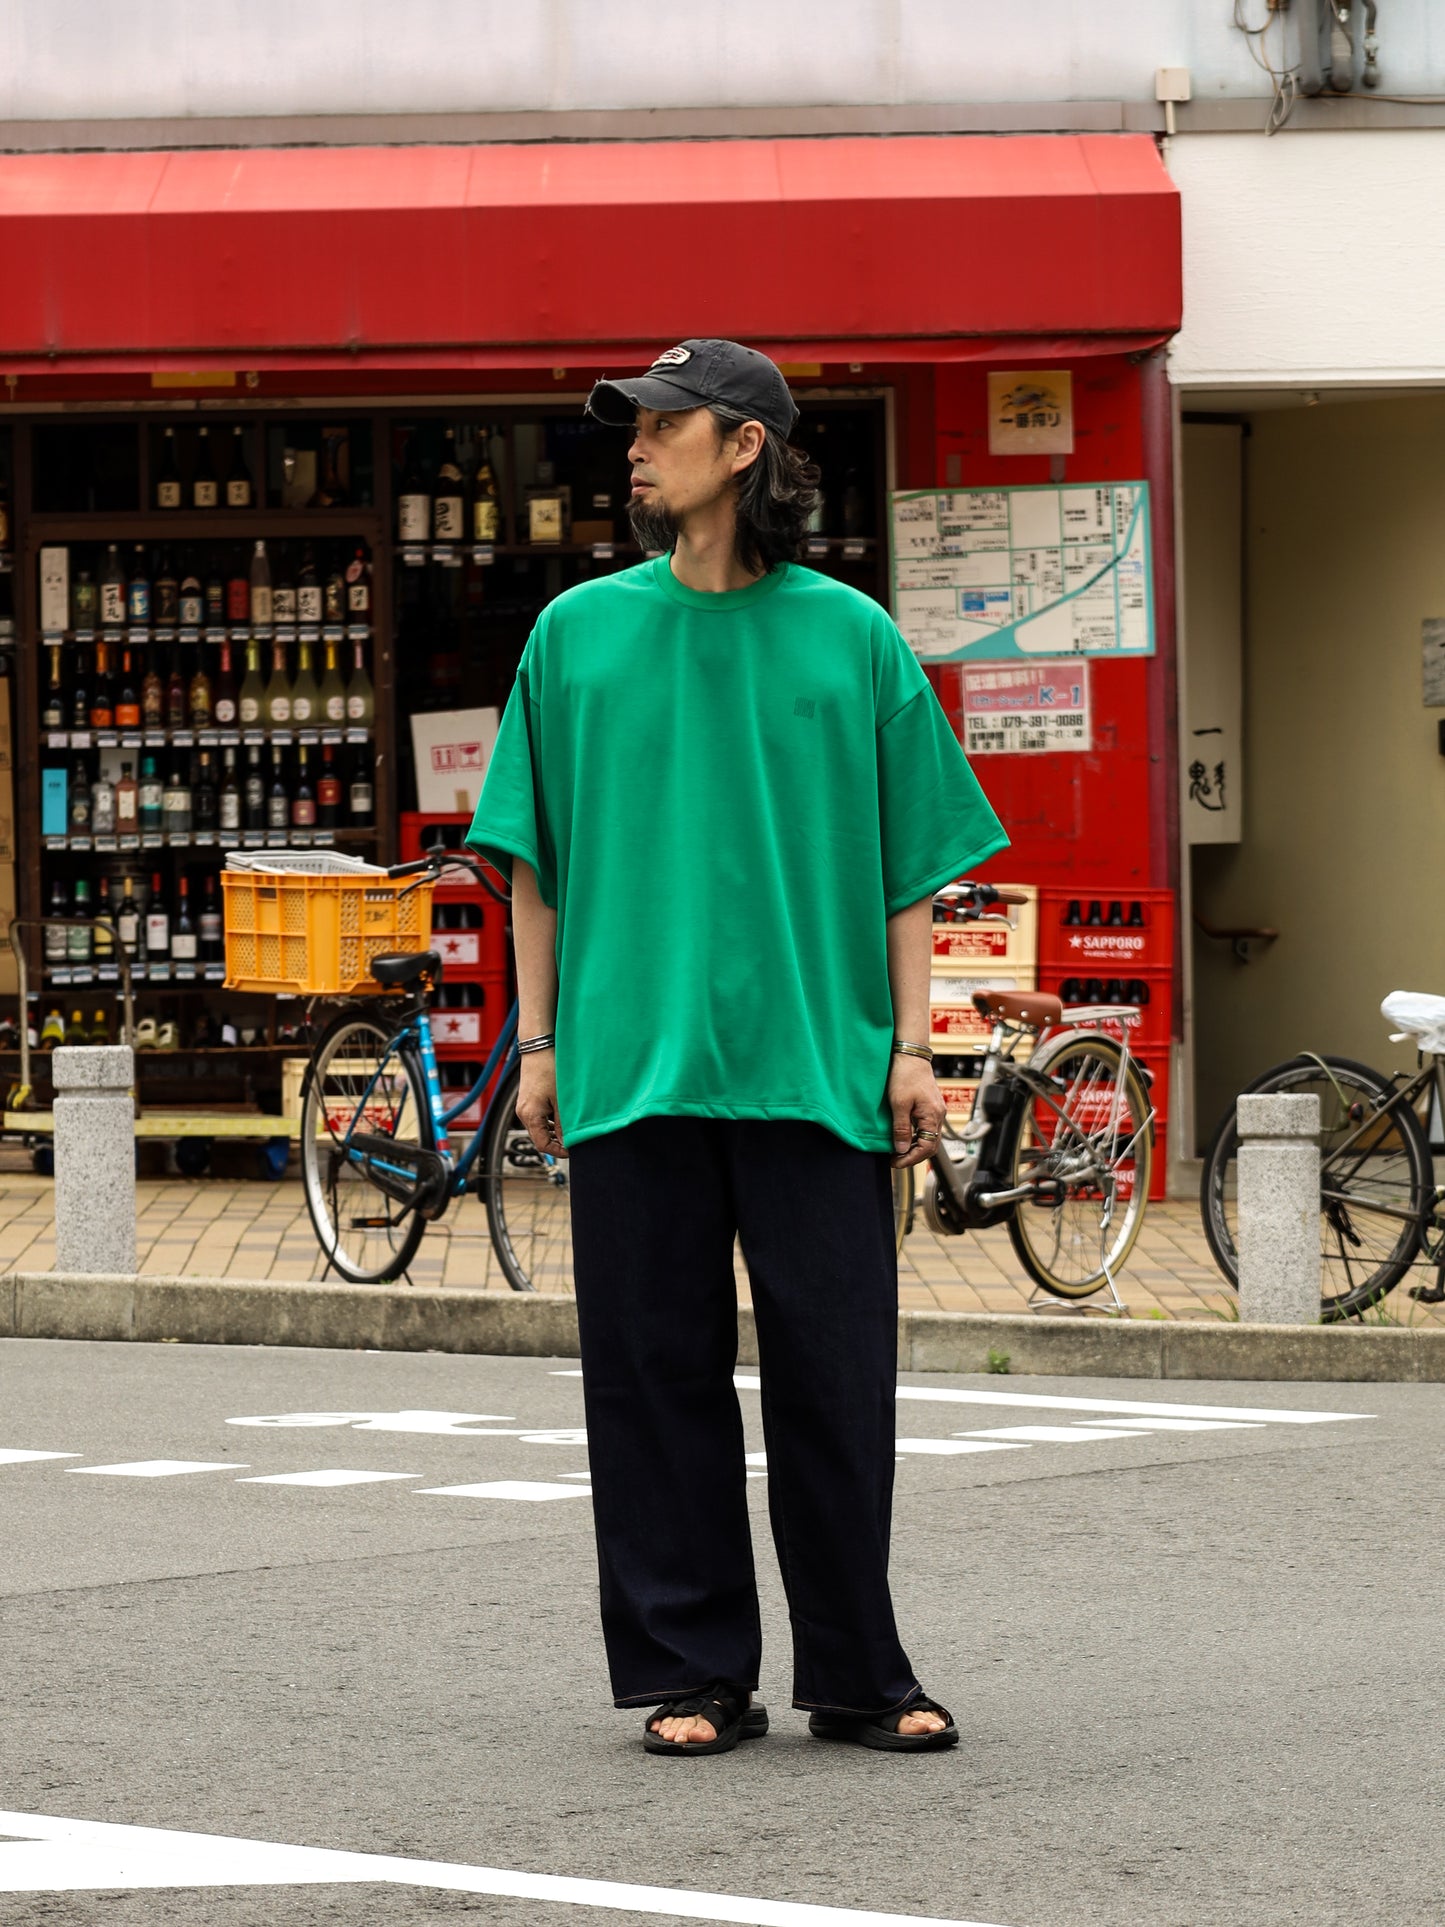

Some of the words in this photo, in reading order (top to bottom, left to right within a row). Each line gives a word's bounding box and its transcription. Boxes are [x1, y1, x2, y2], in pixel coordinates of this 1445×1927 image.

[999, 412, 1061, 428] 一番搾り
[1039, 685, 1081, 707] K-1
[968, 717, 987, 729] TEL
[932, 931, 1006, 946] アサヒビール
[1083, 935, 1145, 950] SAPPORO
